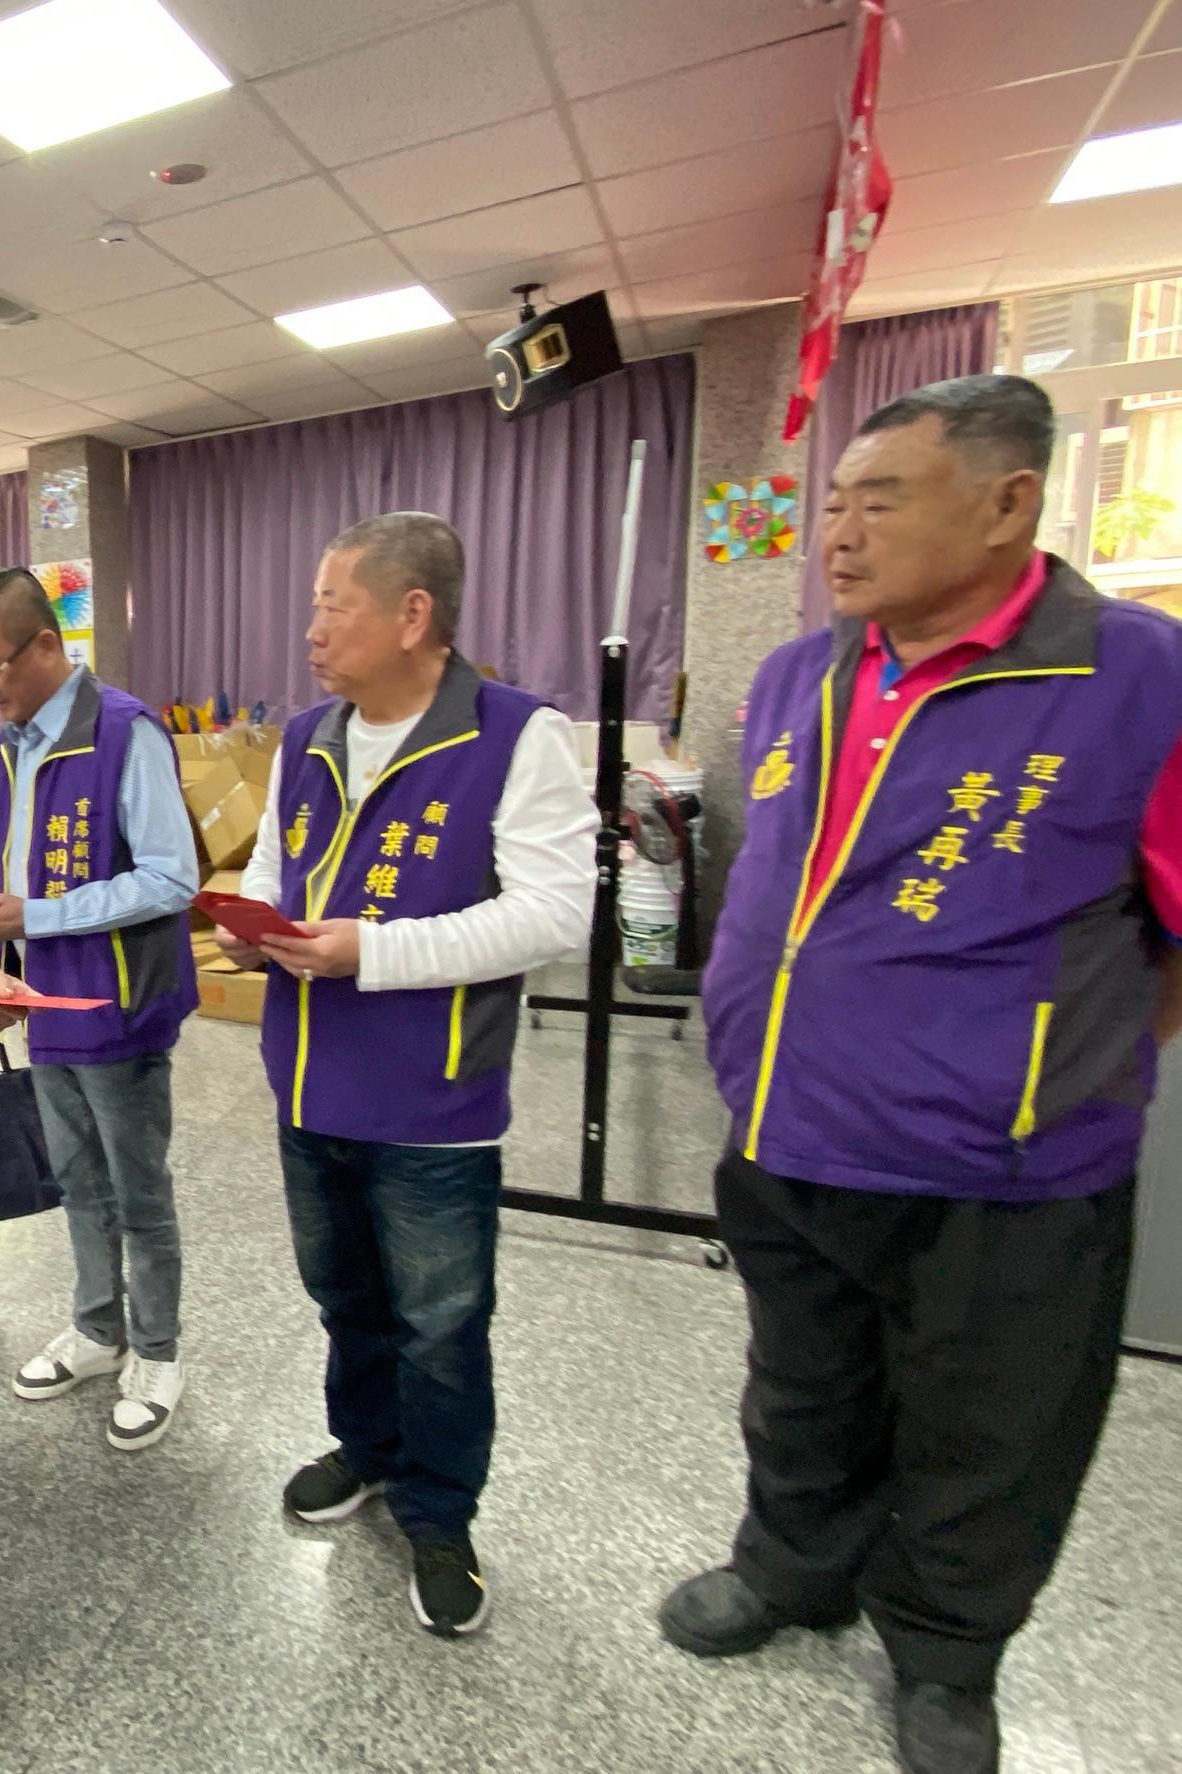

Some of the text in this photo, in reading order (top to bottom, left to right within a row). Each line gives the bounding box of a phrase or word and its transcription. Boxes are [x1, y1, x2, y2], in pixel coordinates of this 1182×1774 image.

[72, 797, 92, 880] 首席顧問
[413, 800, 450, 860] 顧問
[991, 753, 1067, 854] 理事長
